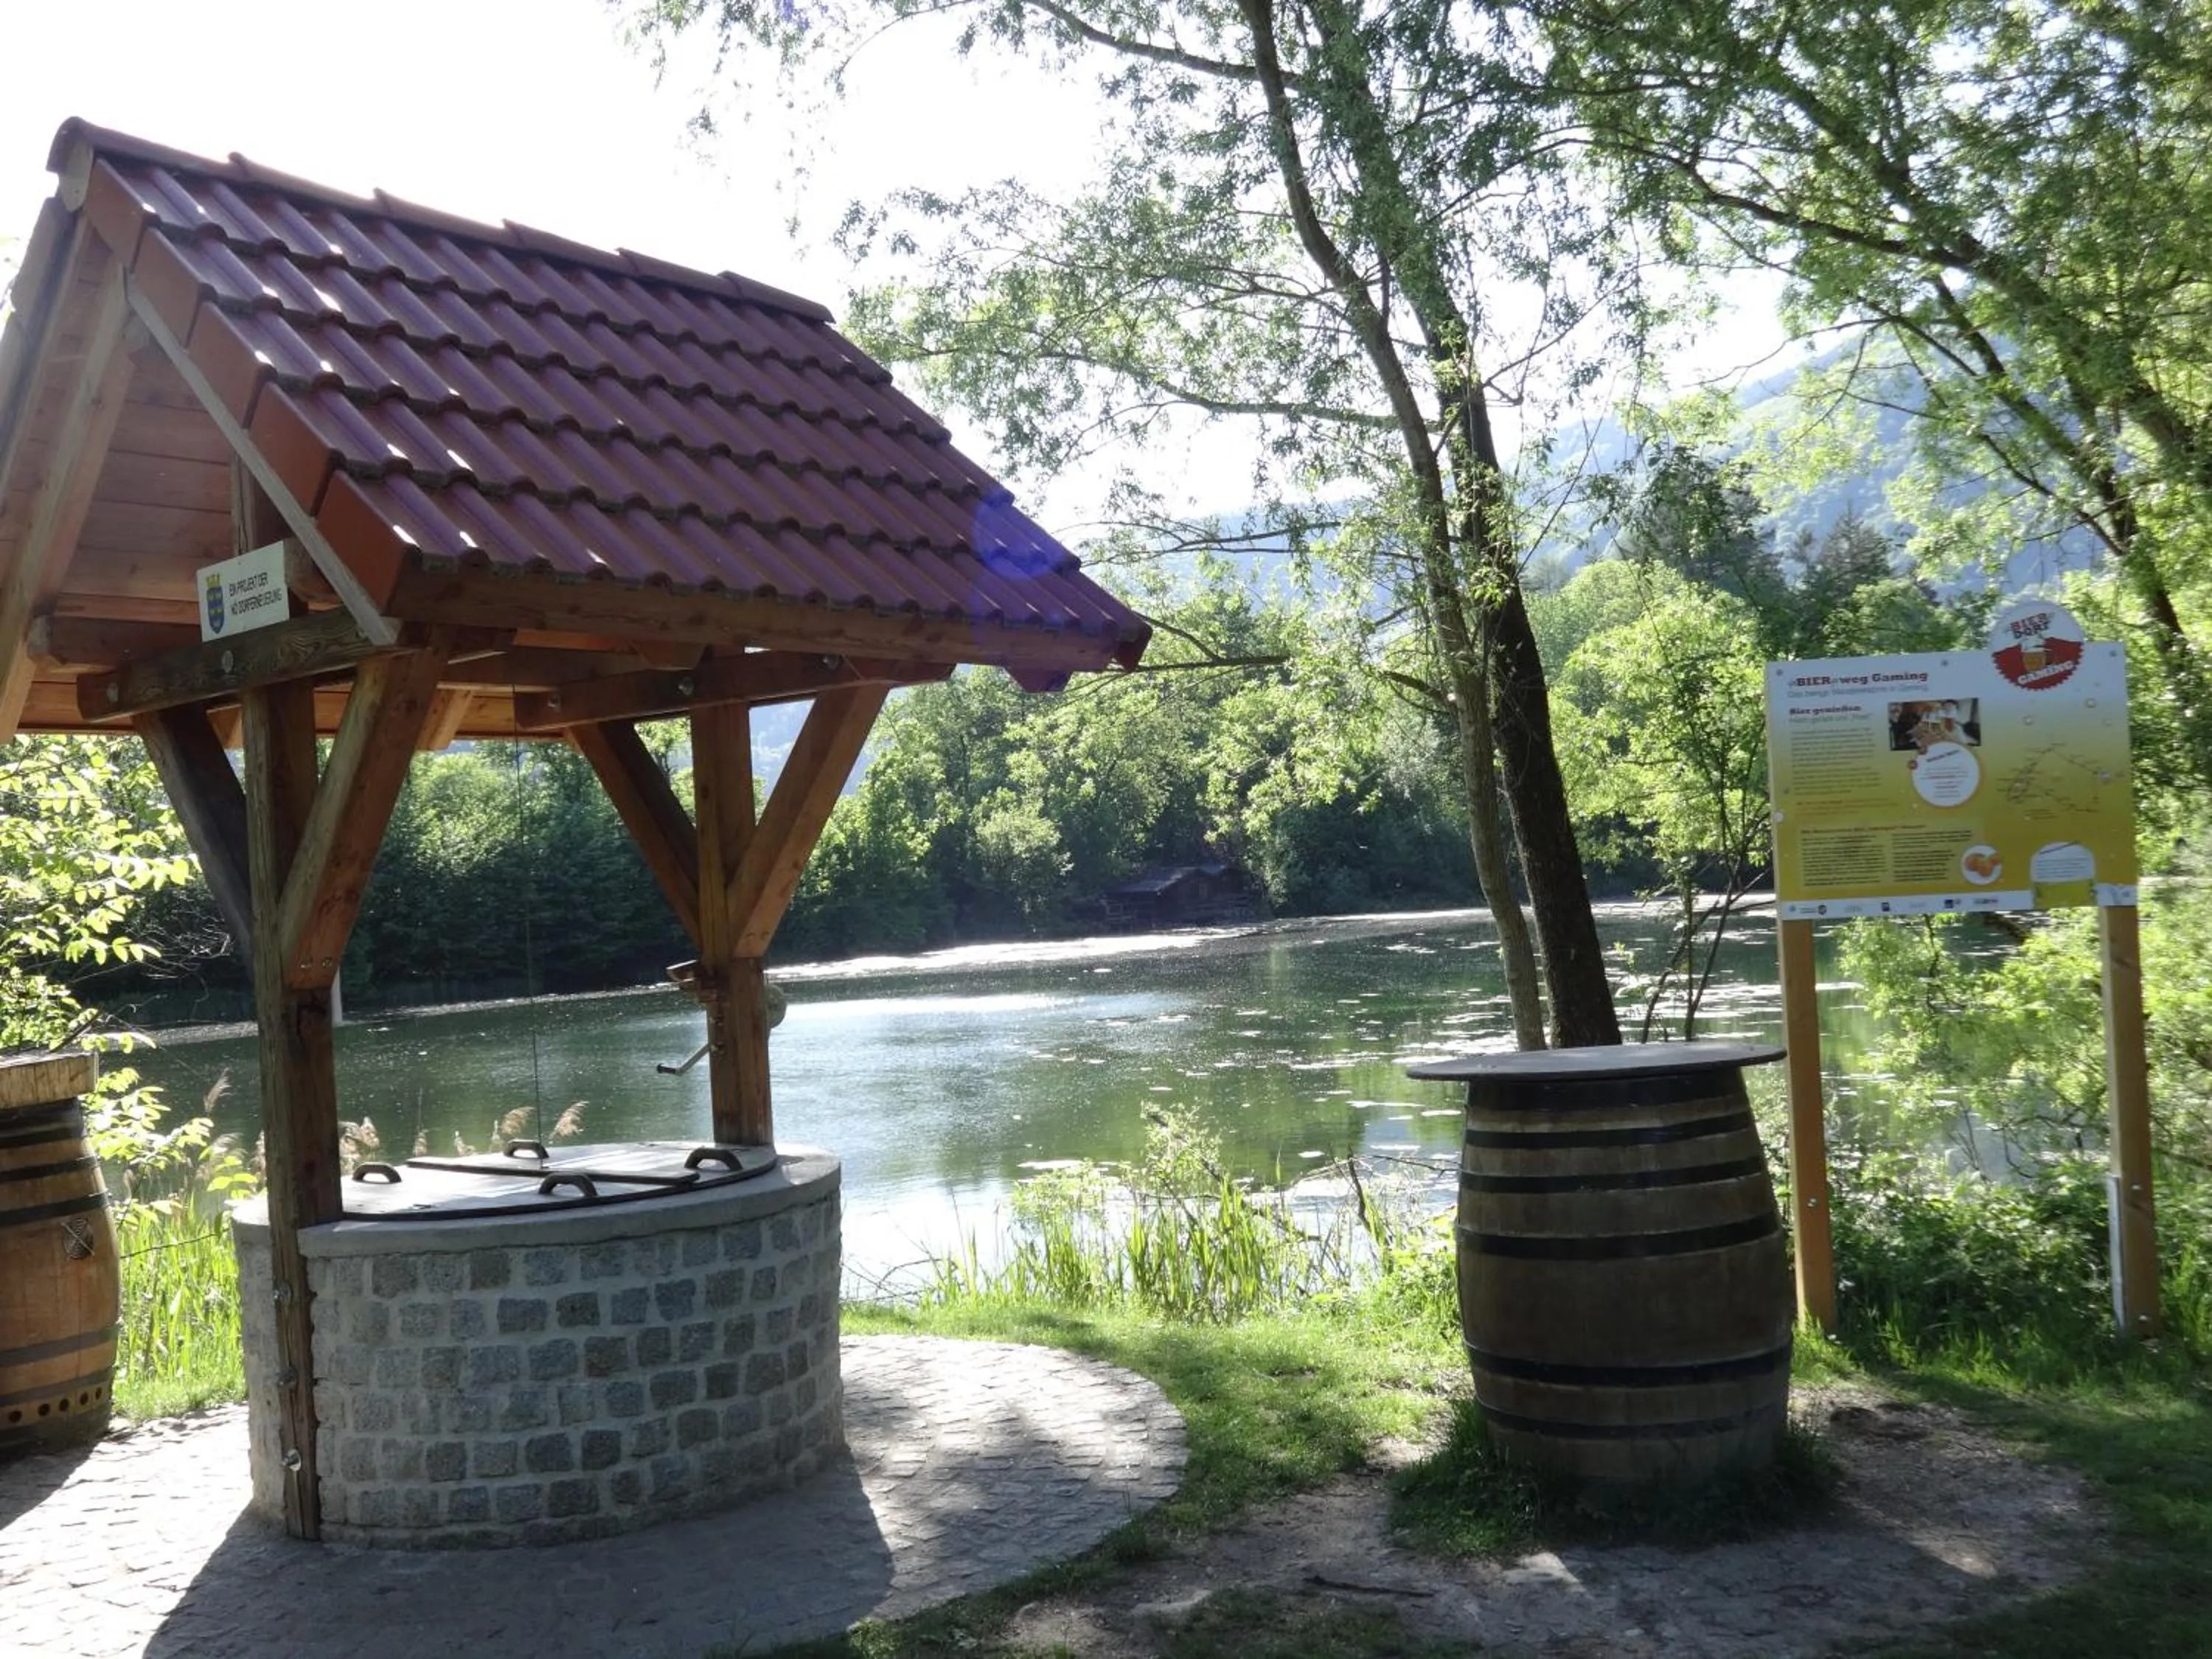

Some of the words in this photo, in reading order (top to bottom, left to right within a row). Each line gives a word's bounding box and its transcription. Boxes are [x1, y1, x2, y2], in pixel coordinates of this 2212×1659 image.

[237, 575, 257, 594] PROJEKT
[258, 571, 269, 587] DER
[2010, 613, 2050, 632] BIER
[1871, 672, 1928, 682] Gaming
[2017, 660, 2074, 685] GAMING
